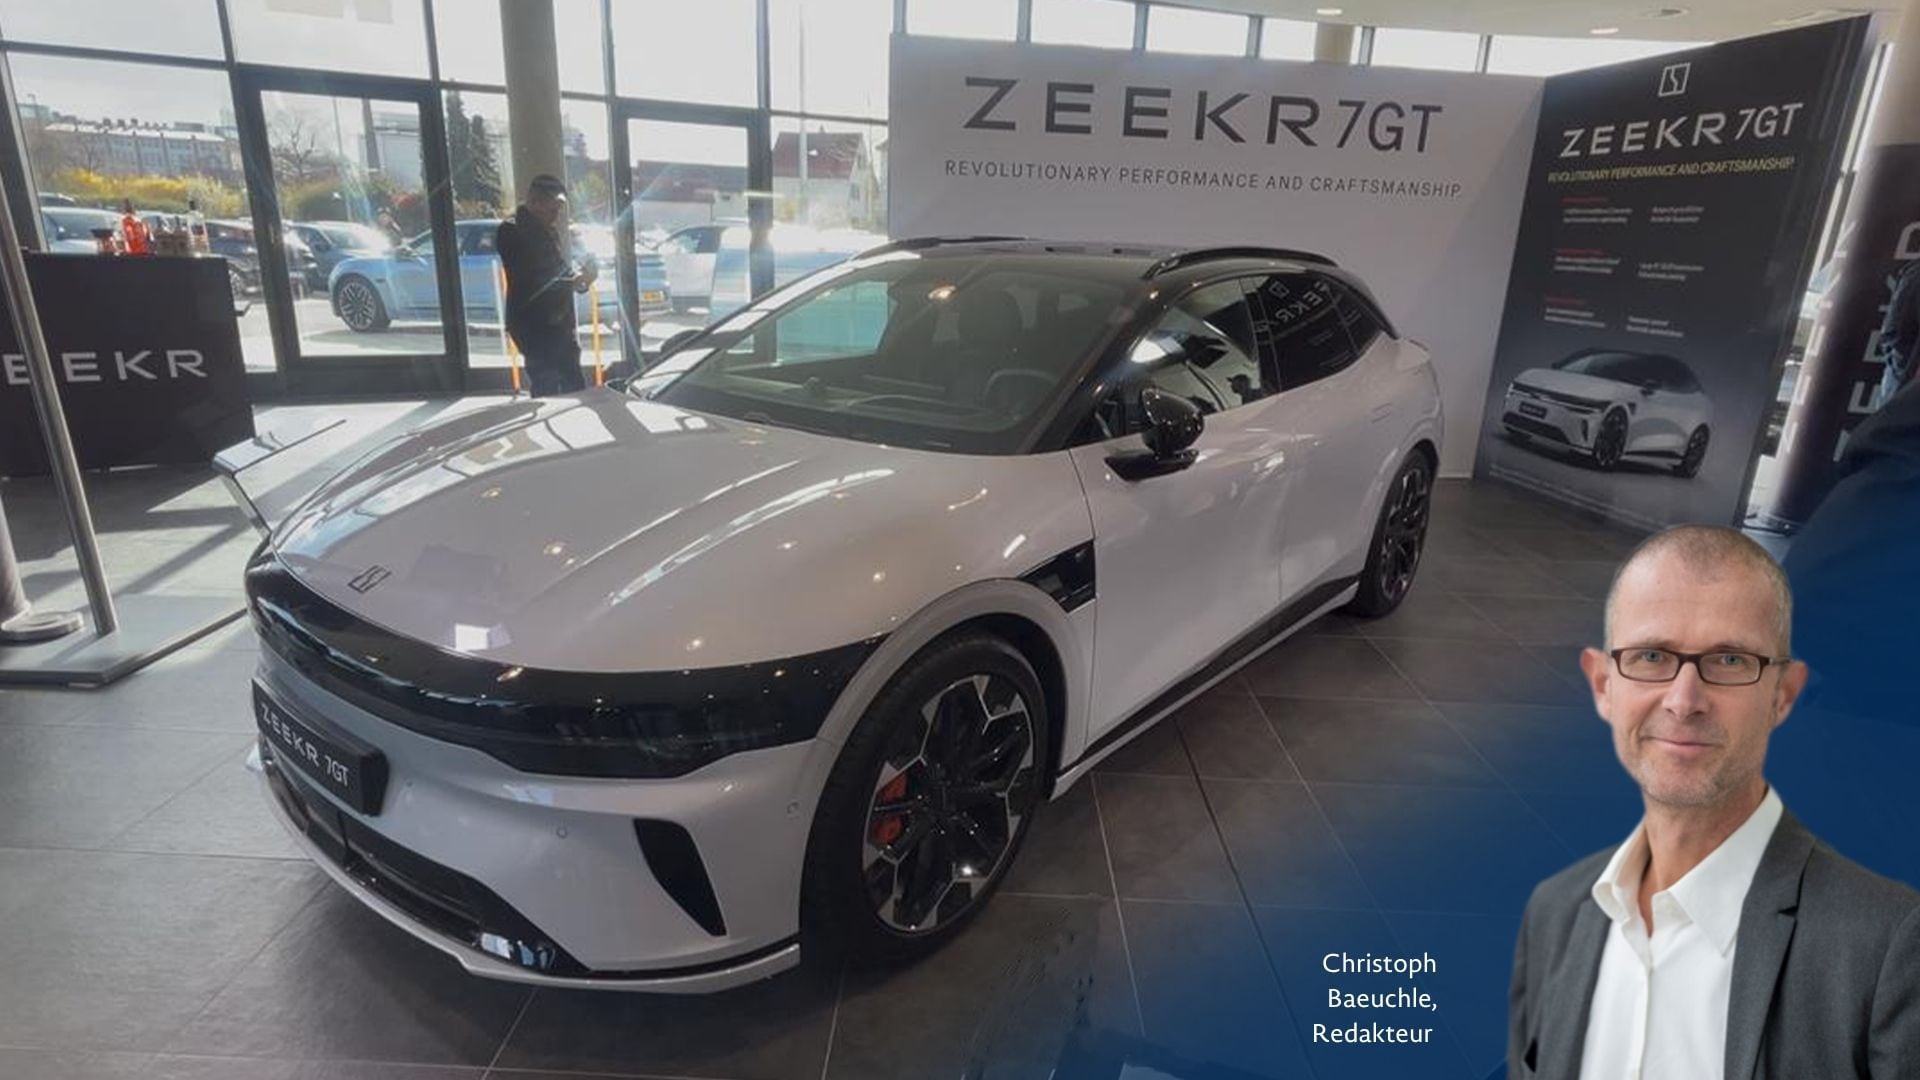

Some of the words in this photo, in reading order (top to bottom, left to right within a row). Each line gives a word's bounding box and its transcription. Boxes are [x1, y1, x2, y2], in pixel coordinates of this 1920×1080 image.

[963, 76, 1318, 147] ZEEKR
[1336, 99, 1443, 153] 7GT
[1559, 113, 1727, 158] ZEEKR
[1735, 103, 1804, 140] 7GT
[945, 159, 1111, 182] REVOLUTIONARY
[1118, 167, 1258, 188] PERFORMANCE
[1265, 175, 1303, 191] AND
[1610, 163, 1678, 180] PERFORMANCE
[1678, 162, 1700, 175] AND
[261, 702, 319, 767] ZEEKR
[324, 754, 349, 786] 7GT
